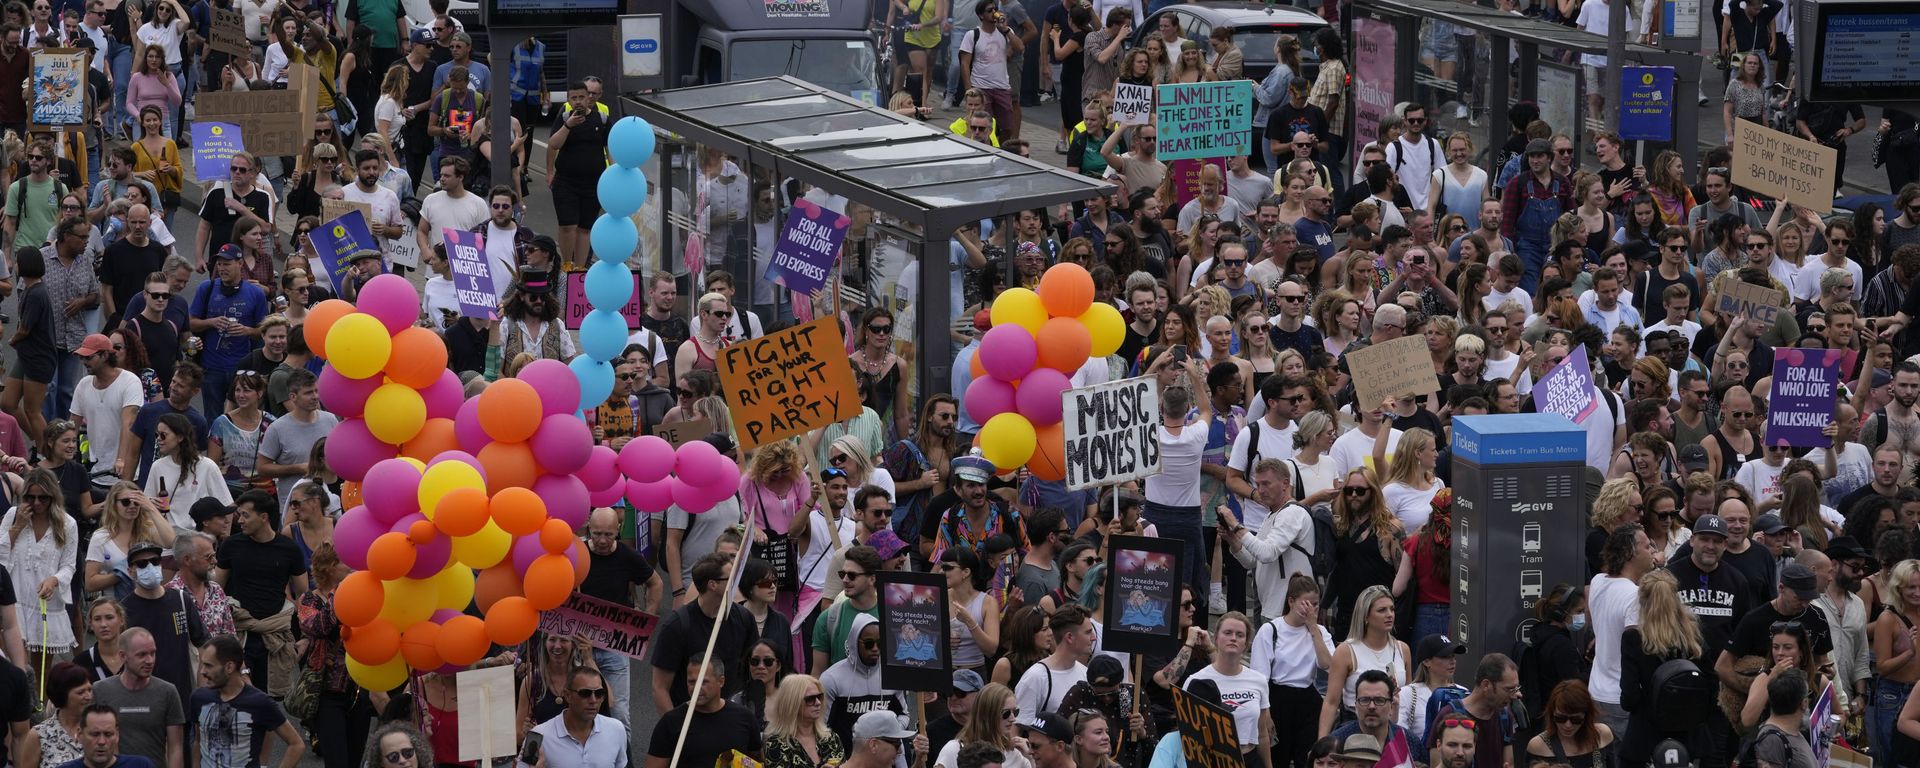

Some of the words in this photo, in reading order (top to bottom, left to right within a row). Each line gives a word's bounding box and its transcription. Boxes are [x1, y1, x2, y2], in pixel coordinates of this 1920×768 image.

[766, 4, 820, 12] MOVING
[1829, 17, 1856, 26] Vertrek
[1858, 17, 1908, 26] bussen/trams
[51, 60, 69, 68] JULI
[1117, 86, 1150, 101] KNAL
[1158, 86, 1235, 106] UNMUTE
[1357, 79, 1392, 107] Banksy
[1114, 101, 1150, 113] DRANG
[1161, 108, 1187, 122] THE
[1189, 106, 1221, 120] ONES
[1225, 104, 1243, 116] WE
[1179, 121, 1211, 133] WANT
[1215, 119, 1230, 130] TO
[1160, 138, 1191, 153] HEAR
[1192, 135, 1213, 150] THE
[1215, 130, 1251, 147] MOST
[1743, 127, 1764, 145] SOLD
[1766, 137, 1780, 150] MY
[1782, 142, 1819, 162] DRUMSET
[1744, 143, 1757, 156] TO
[1761, 149, 1775, 161] PAY
[1780, 156, 1798, 171] THE
[1800, 161, 1824, 179] RENT
[1768, 170, 1787, 188] DUM
[797, 217, 817, 235] FOR
[815, 225, 832, 242] ALL
[335, 241, 358, 255] Minder
[788, 228, 811, 247] WHO
[809, 237, 834, 256] LOVE
[455, 244, 479, 262] QUEER
[452, 259, 489, 278] NIGHTLIFE
[775, 251, 788, 266] TO
[786, 257, 825, 281] EXPRESS
[470, 276, 478, 290] IS
[457, 289, 497, 308] NECESSARY
[1760, 288, 1783, 307] US
[1720, 294, 1777, 324] DANCE
[725, 325, 817, 374] FIGHT
[777, 351, 816, 379] YOUR
[1360, 368, 1371, 378] IK
[1377, 361, 1392, 373] HEB
[1565, 362, 1573, 373] &
[1787, 366, 1806, 382] FOR
[1808, 367, 1825, 382] ALL
[1368, 369, 1400, 389] GEEN
[1546, 368, 1565, 391] 2021
[1567, 370, 1578, 385] IN
[1547, 379, 1568, 402] 2020
[1780, 381, 1804, 397] WHO
[1805, 382, 1830, 398] LOVE
[778, 394, 806, 410] TO
[1076, 382, 1149, 436] MUSIC
[1565, 392, 1592, 420] MILKS
[746, 390, 839, 445] PARTY
[1773, 411, 1829, 427] MILKSHAKE
[1454, 431, 1478, 455] Tickets
[1540, 446, 1554, 454] Bus
[1066, 428, 1136, 486] MOVES
[1139, 423, 1159, 468] US
[1464, 499, 1473, 510] GVB
[1532, 503, 1553, 511] GVB
[1709, 517, 1718, 527] NY
[1520, 555, 1543, 563] Tram
[1121, 577, 1133, 585] Nog
[1677, 588, 1735, 607] HARLEM
[891, 610, 903, 618] Nog
[607, 629, 649, 656] MAAT
[1221, 692, 1255, 700] eebok
[1171, 687, 1237, 749] RUTTE
